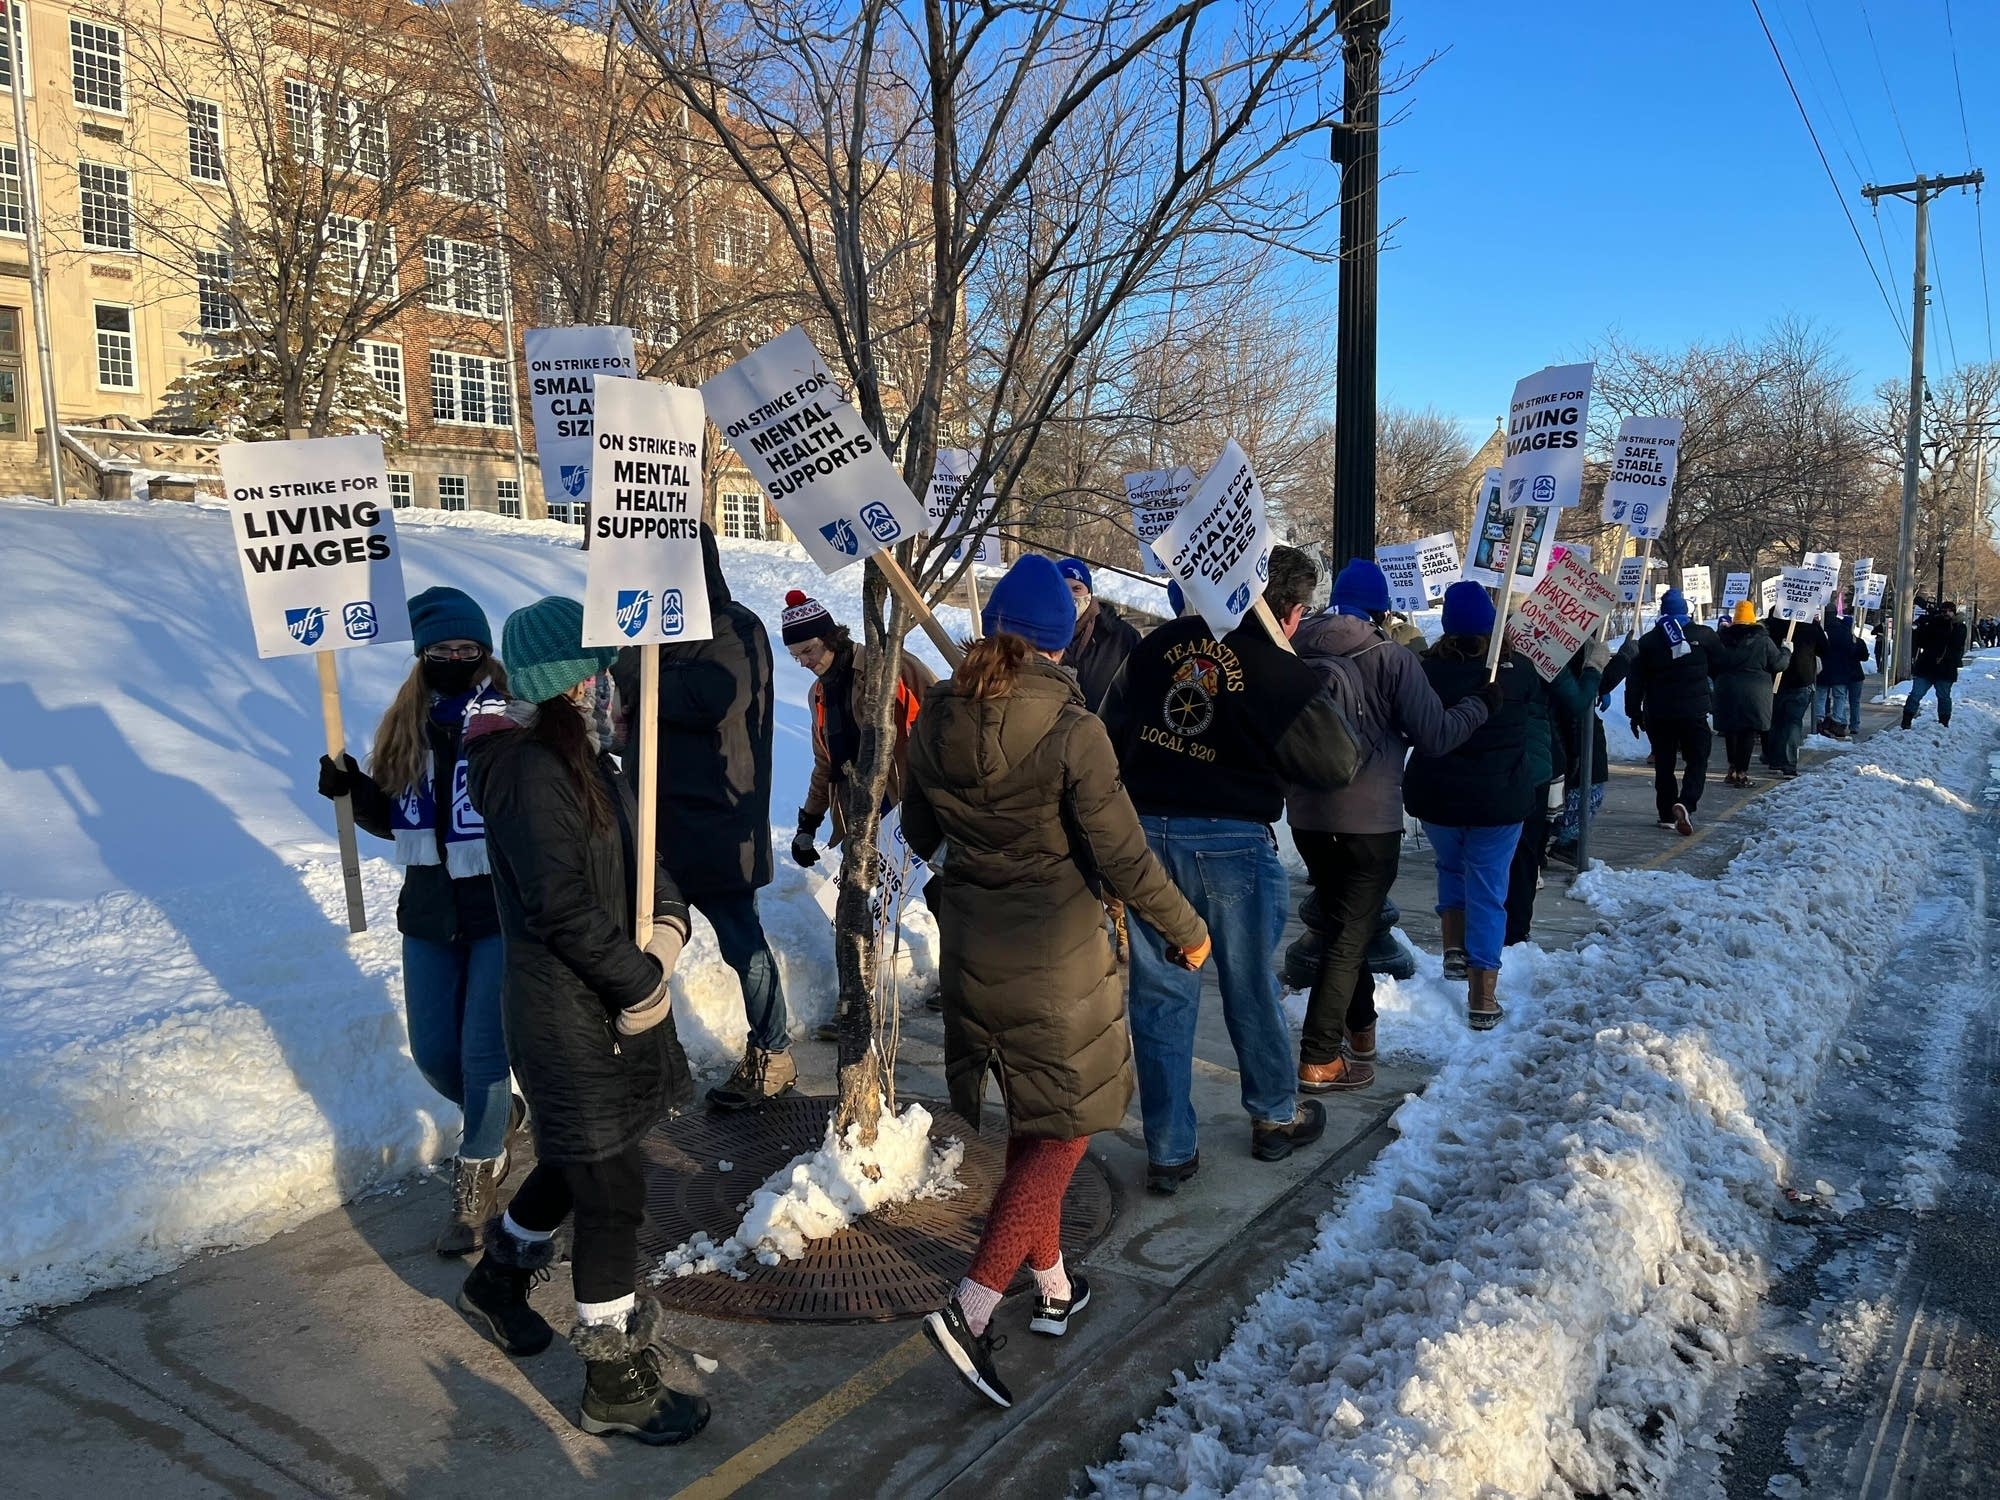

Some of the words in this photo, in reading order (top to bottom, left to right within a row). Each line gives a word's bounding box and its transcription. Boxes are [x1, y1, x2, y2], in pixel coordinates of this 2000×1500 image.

[532, 360, 552, 372] ON
[554, 358, 600, 371] STRIKE
[603, 357, 631, 369] FOR
[551, 399, 594, 416] CLA
[727, 419, 750, 438] ON
[749, 392, 797, 425] STRIKE
[796, 372, 832, 400] FOR
[1512, 402, 1524, 413] ON
[1526, 393, 1558, 408] STRIKE
[1560, 390, 1584, 401] FOR
[557, 420, 594, 437] SIZ
[750, 401, 832, 455] MENTAL
[1511, 407, 1579, 436] LIVING
[600, 434, 623, 451] ON
[629, 436, 676, 455] STRIKE
[678, 442, 696, 458] FOR
[766, 422, 844, 474] HEALTH
[1507, 430, 1578, 458] WAGES
[1629, 436, 1657, 445] STRIKE
[1658, 438, 1676, 446] FOR
[1624, 446, 1658, 461] SAFE,
[614, 460, 690, 487] MENTAL
[768, 434, 873, 500] SUPPORTS
[1617, 459, 1663, 473] STABLE
[234, 487, 264, 502] ON
[270, 480, 336, 498] STRIKE
[341, 476, 378, 492] FOR
[939, 474, 968, 482] STRIKE
[1610, 470, 1667, 486] SCHOOLS
[616, 489, 687, 513] HEALTH
[243, 501, 380, 539] LIVING
[1142, 512, 1178, 524] STAB
[1172, 542, 1190, 566] ON
[1190, 494, 1228, 544] STRIKE
[1228, 464, 1248, 496] FOR
[597, 516, 698, 540] SUPPORTS
[876, 521, 891, 533] ESP
[1180, 476, 1254, 580] SMALLER
[1201, 504, 1253, 577] CLASS
[1442, 542, 1454, 550] FOR
[244, 534, 391, 574] WAGES
[1211, 522, 1256, 586] SIZES
[1422, 558, 1452, 570] STABLE
[1424, 552, 1448, 562] SAFE,
[1382, 562, 1418, 572] SMALLER
[1420, 564, 1458, 578] SCHOOLS
[1563, 575, 1583, 592] ARE
[1584, 588, 1600, 602] THE
[1782, 582, 1820, 592] SMALLER
[1786, 589, 1812, 597] CLASS
[353, 622, 370, 632] ESP
[666, 614, 679, 625] ESP
[1520, 600, 1582, 653] COMMUNITIES
[1164, 638, 1245, 692] TEAMSTERS
[1531, 648, 1543, 662] IN
[1140, 726, 1184, 752] LOCAL
[1189, 742, 1216, 762] 320
